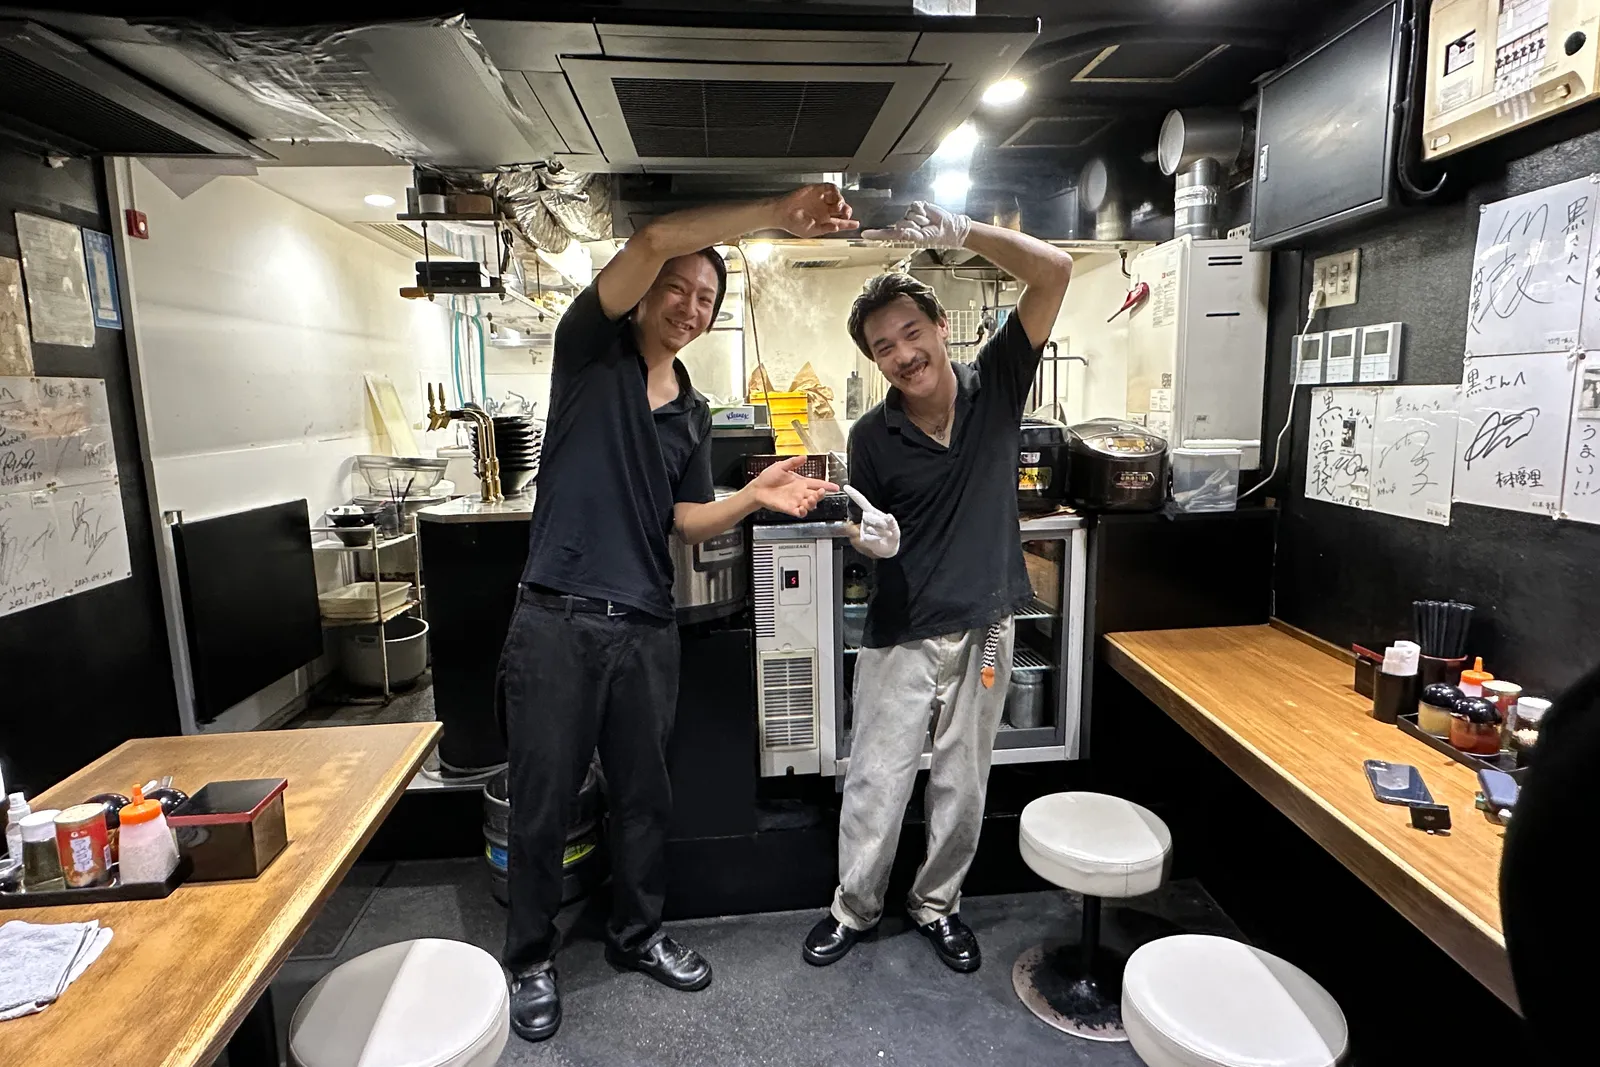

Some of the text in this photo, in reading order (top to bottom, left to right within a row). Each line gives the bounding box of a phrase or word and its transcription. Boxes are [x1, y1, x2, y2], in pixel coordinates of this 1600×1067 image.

[1466, 368, 1526, 398] 黒さんへ
[726, 411, 750, 421] Kleenex
